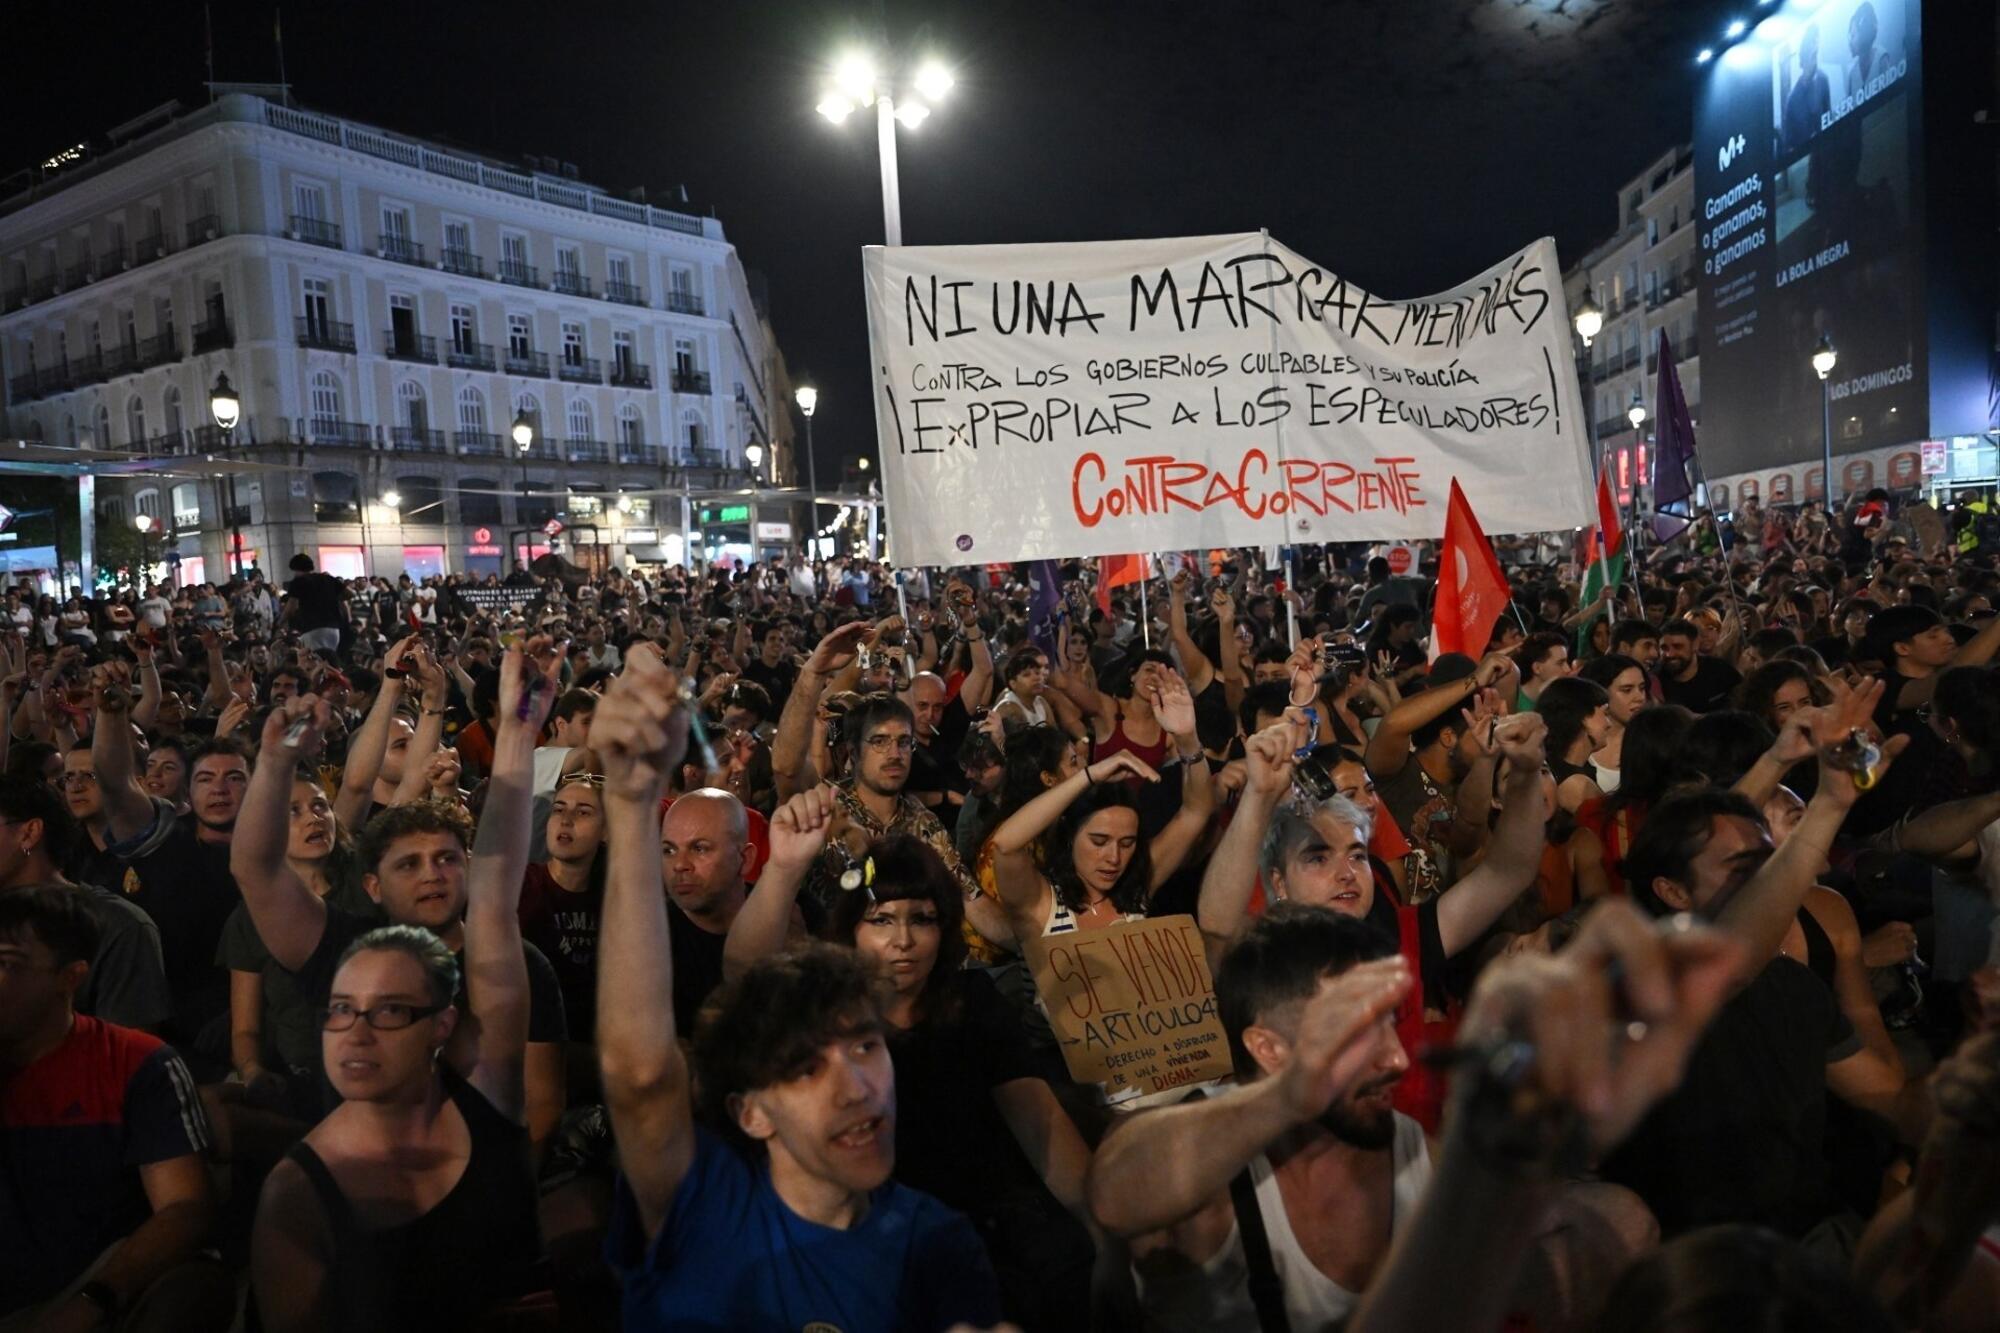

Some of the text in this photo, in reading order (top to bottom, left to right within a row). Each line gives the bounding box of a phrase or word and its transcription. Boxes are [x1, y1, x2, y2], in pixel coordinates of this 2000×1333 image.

[1821, 60, 1906, 131] EL SER QUERIDO
[1705, 173, 1762, 220] Ganamos,
[1703, 200, 1767, 249] o ganamos,
[1705, 228, 1766, 275] o ganamos
[1776, 270, 1788, 287] LA
[1789, 257, 1814, 282] BOLA
[1815, 240, 1850, 269] NEGRA
[904, 274, 977, 346] NI
[992, 279, 1105, 338] UNA
[1016, 363, 1069, 387] LOS
[1087, 353, 1228, 386] GOBIERNOS
[1241, 352, 1360, 375] CULPABLES
[1363, 361, 1376, 380] Y
[1380, 366, 1402, 383] SU
[1403, 358, 1480, 388] POLICÍA
[1171, 401, 1201, 425] A
[1214, 385, 1292, 428] LOS
[1305, 346, 1560, 436] ESPECULADORES!
[1831, 363, 1913, 400] LOS DOMINGOS
[1049, 926, 1214, 1019] SE VENDE
[1084, 1001, 1202, 1052] ARTÍCULO
[1105, 1048, 1157, 1069] DERECHO
[1163, 1044, 1171, 1052] A
[1113, 1074, 1128, 1085] DE
[1134, 1066, 1159, 1079] UNA
